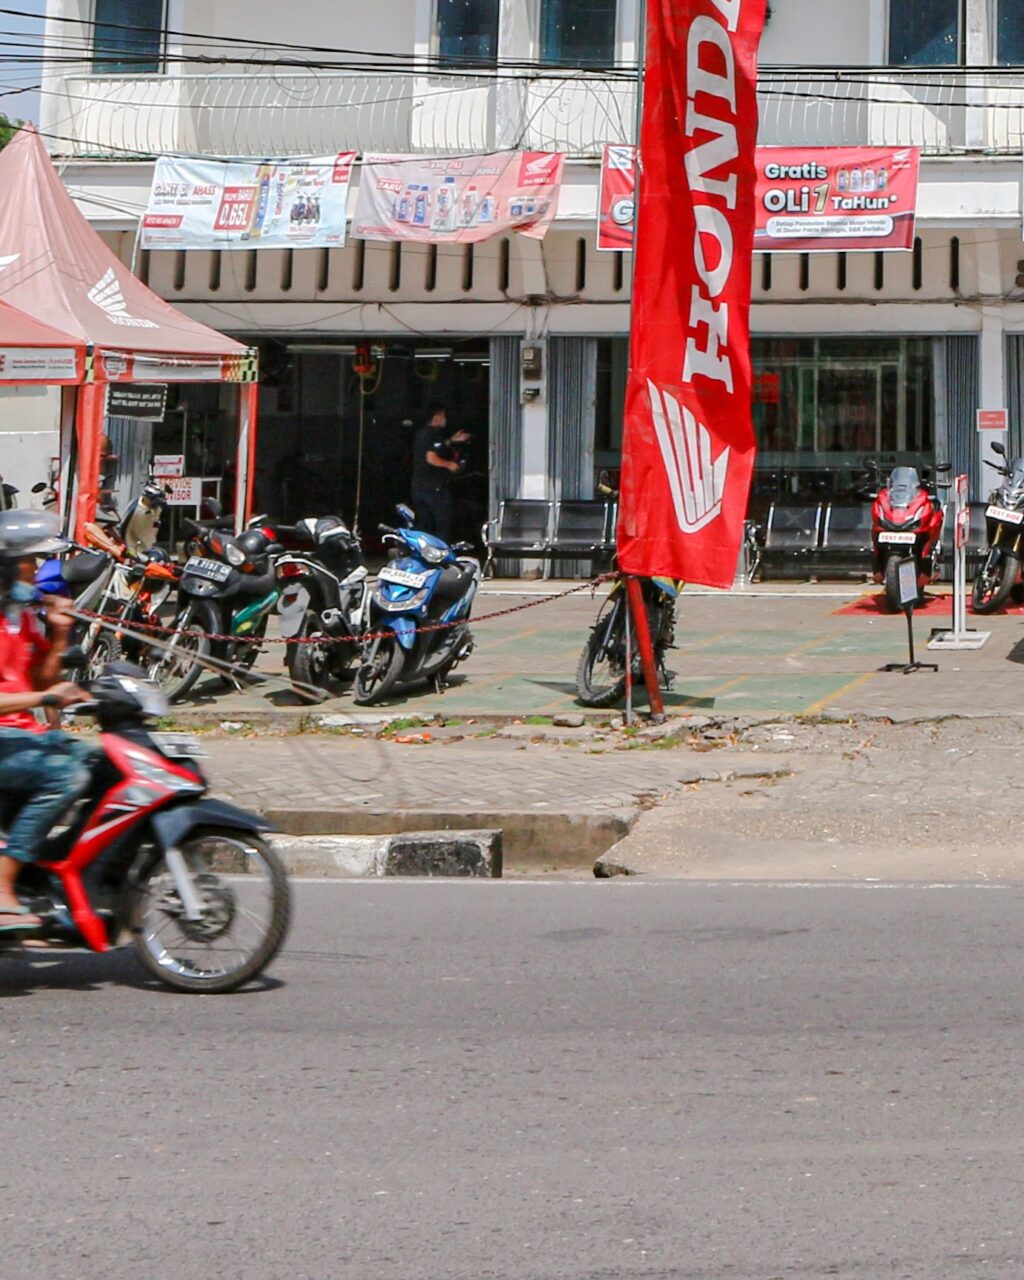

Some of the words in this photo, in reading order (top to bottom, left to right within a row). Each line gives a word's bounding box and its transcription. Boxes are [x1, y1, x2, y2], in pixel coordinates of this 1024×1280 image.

[764, 161, 828, 180] Gratis
[192, 185, 216, 195] AHASS
[812, 183, 831, 214] 1
[165, 489, 192, 500] DVISOR
